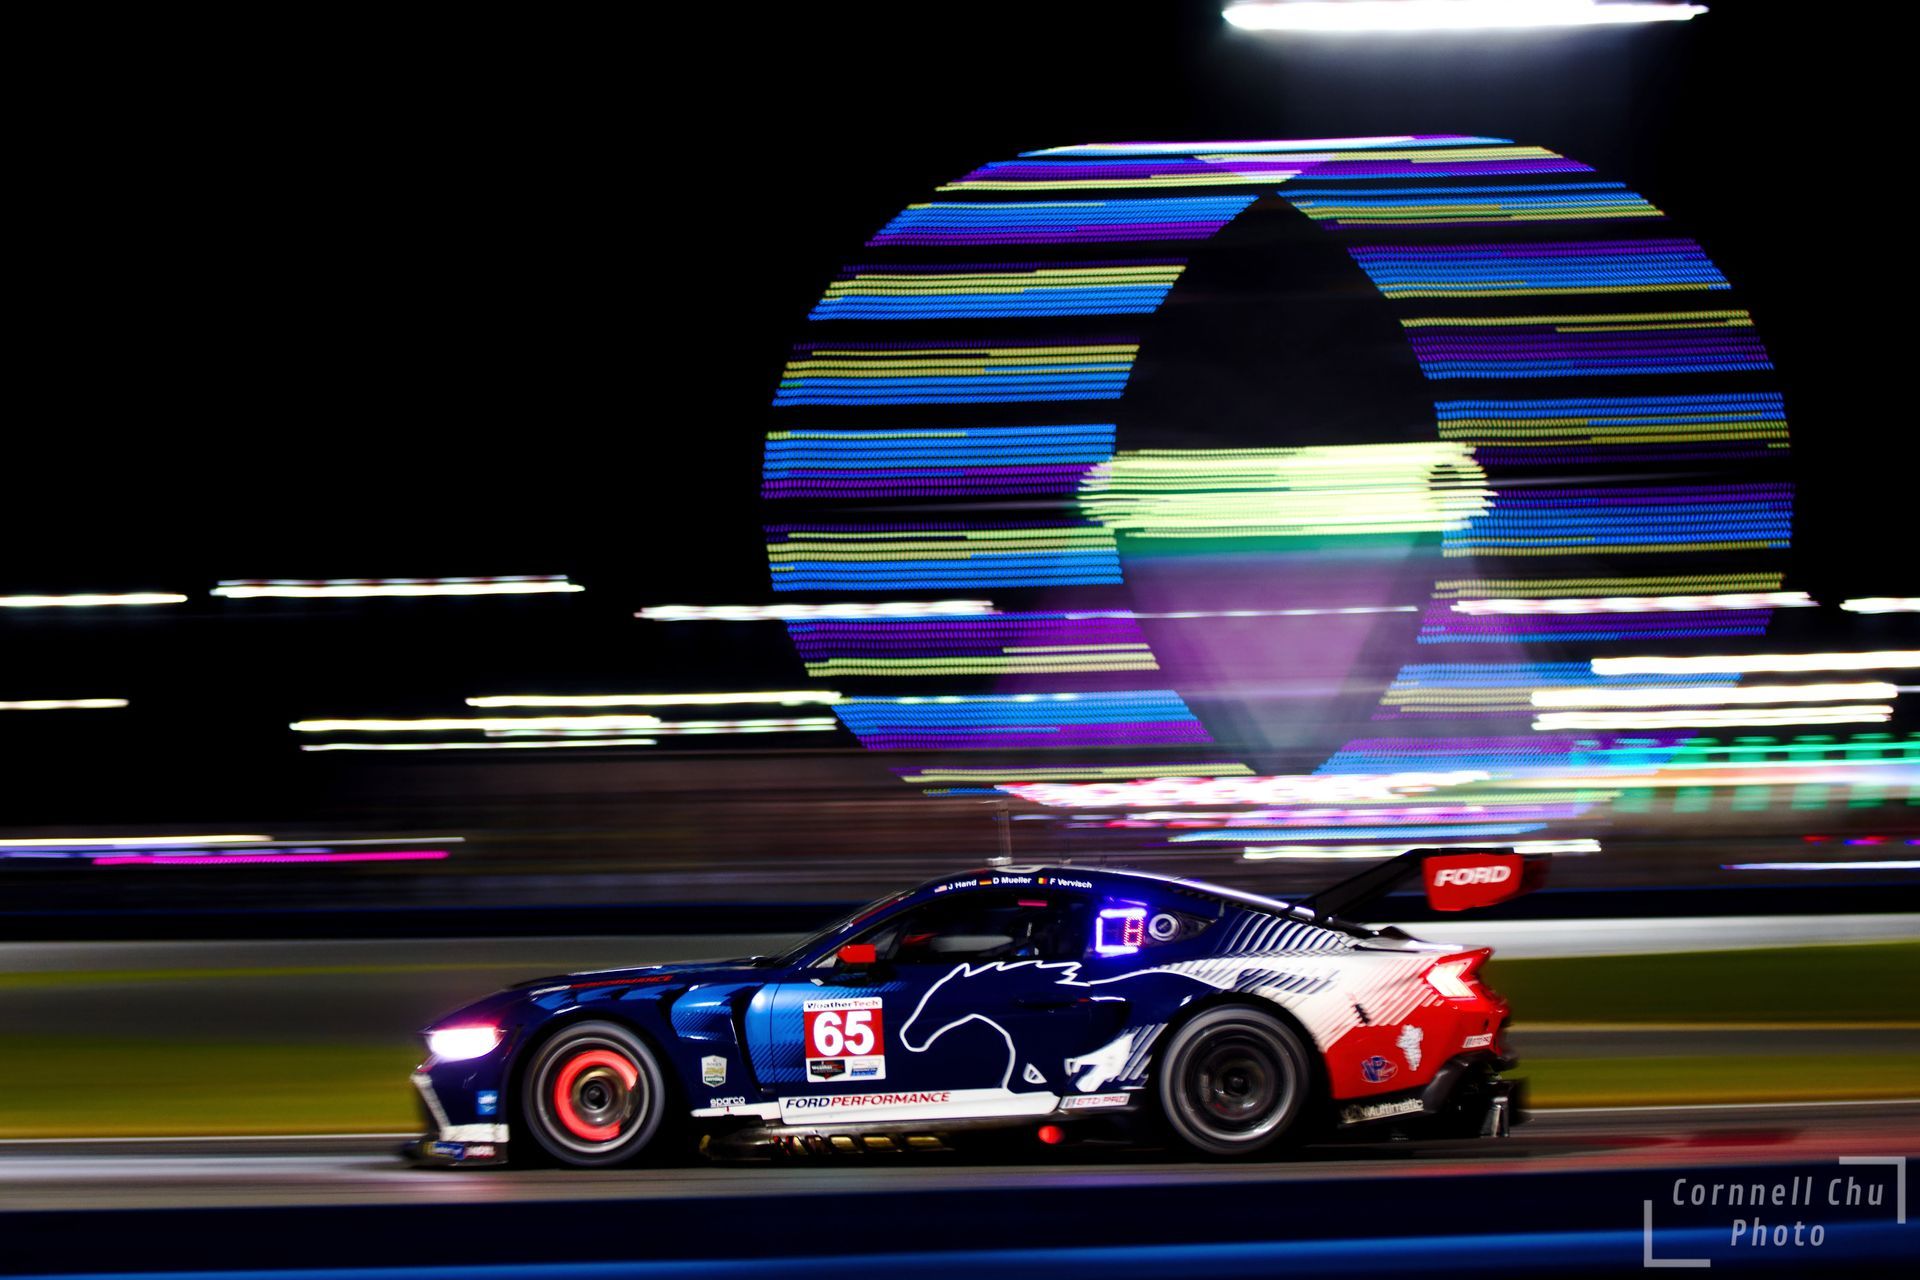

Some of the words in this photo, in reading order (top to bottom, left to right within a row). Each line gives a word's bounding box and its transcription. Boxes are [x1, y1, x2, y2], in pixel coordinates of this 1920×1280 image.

[993, 877, 1000, 885] D
[1001, 876, 1032, 884] Mueller
[1433, 865, 1512, 887] FORD
[948, 882, 953, 890] J
[955, 879, 977, 889] Hand
[1057, 878, 1093, 889] Vervisch
[813, 1010, 875, 1057] 65
